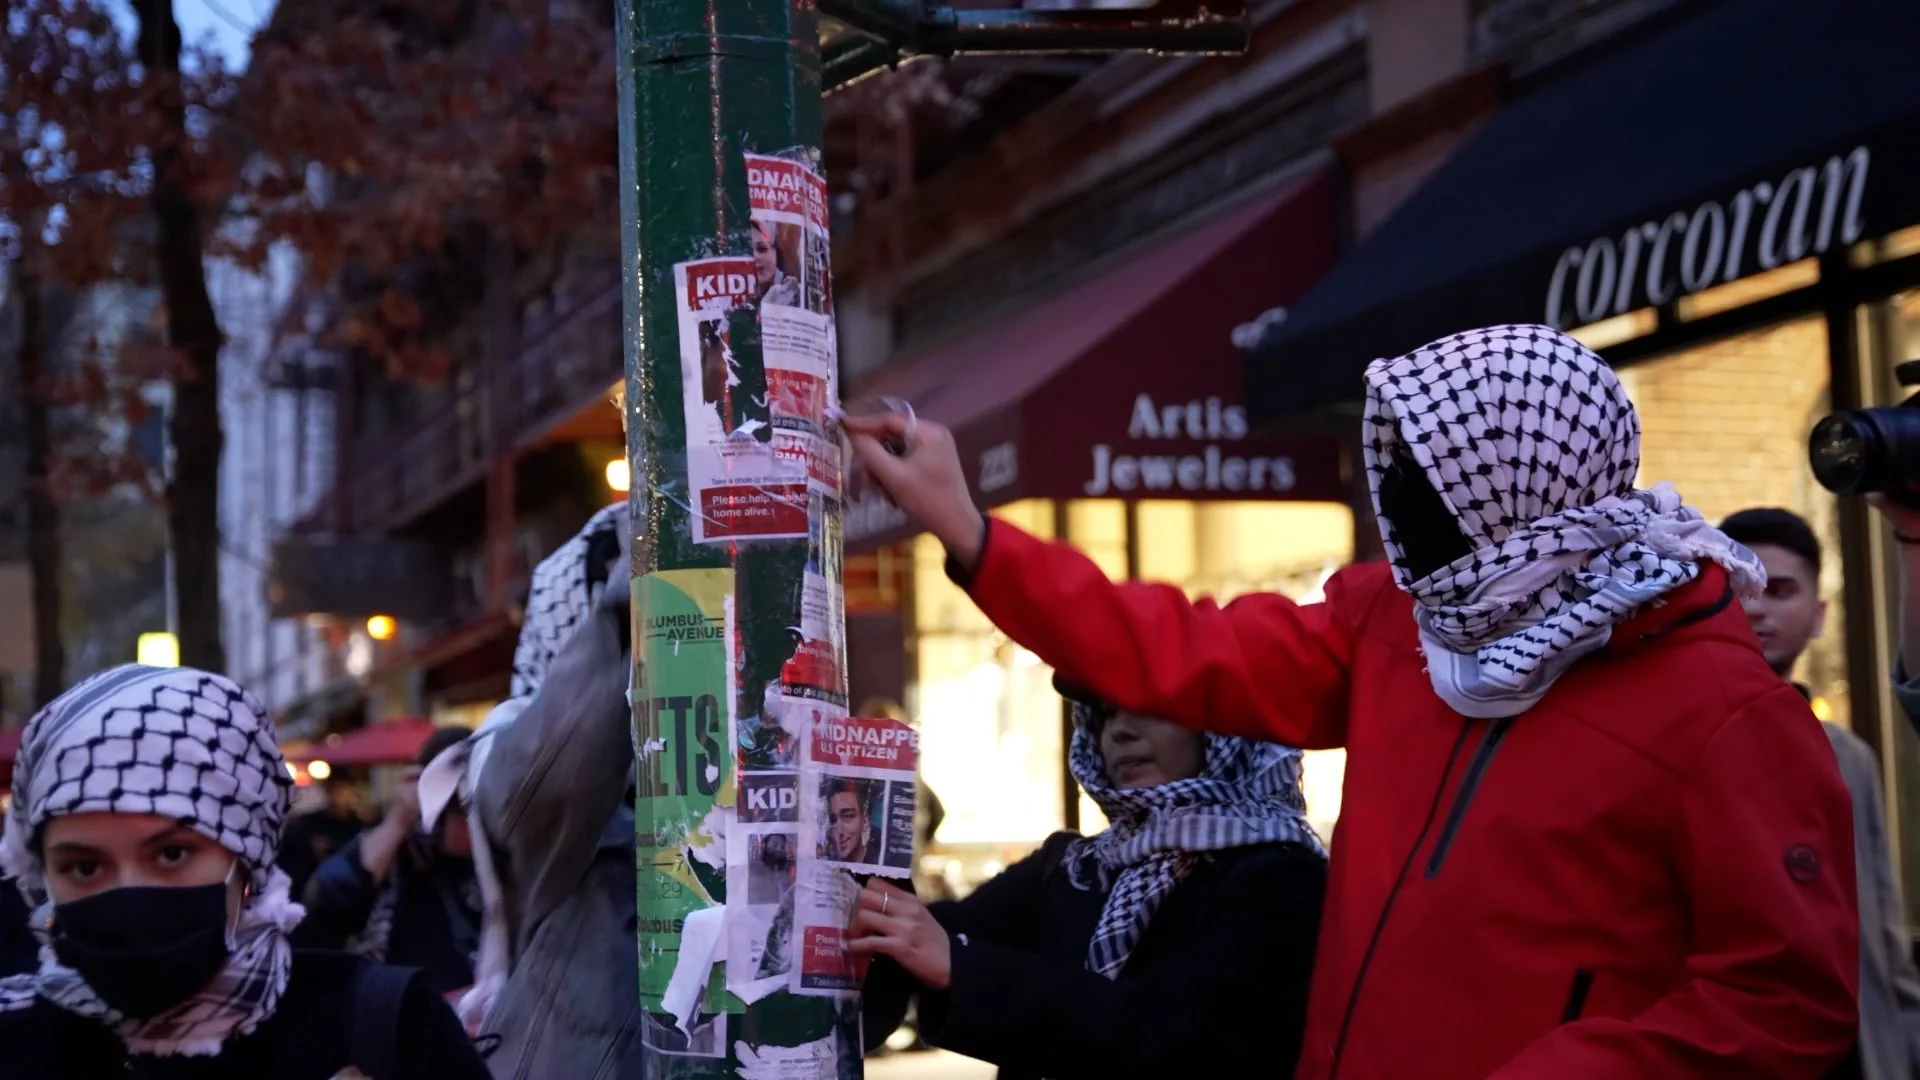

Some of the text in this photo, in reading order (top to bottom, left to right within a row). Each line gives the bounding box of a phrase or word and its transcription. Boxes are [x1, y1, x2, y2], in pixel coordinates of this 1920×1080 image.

[1545, 145, 1870, 330] corcoran
[1129, 394, 1247, 440] Artis
[1085, 444, 1295, 496] Jewelers
[712, 494, 747, 506] Please
[748, 493, 770, 506] help
[713, 506, 770, 519] home alive.
[666, 626, 725, 640] AVENUE
[835, 743, 898, 760] CITIZEN
